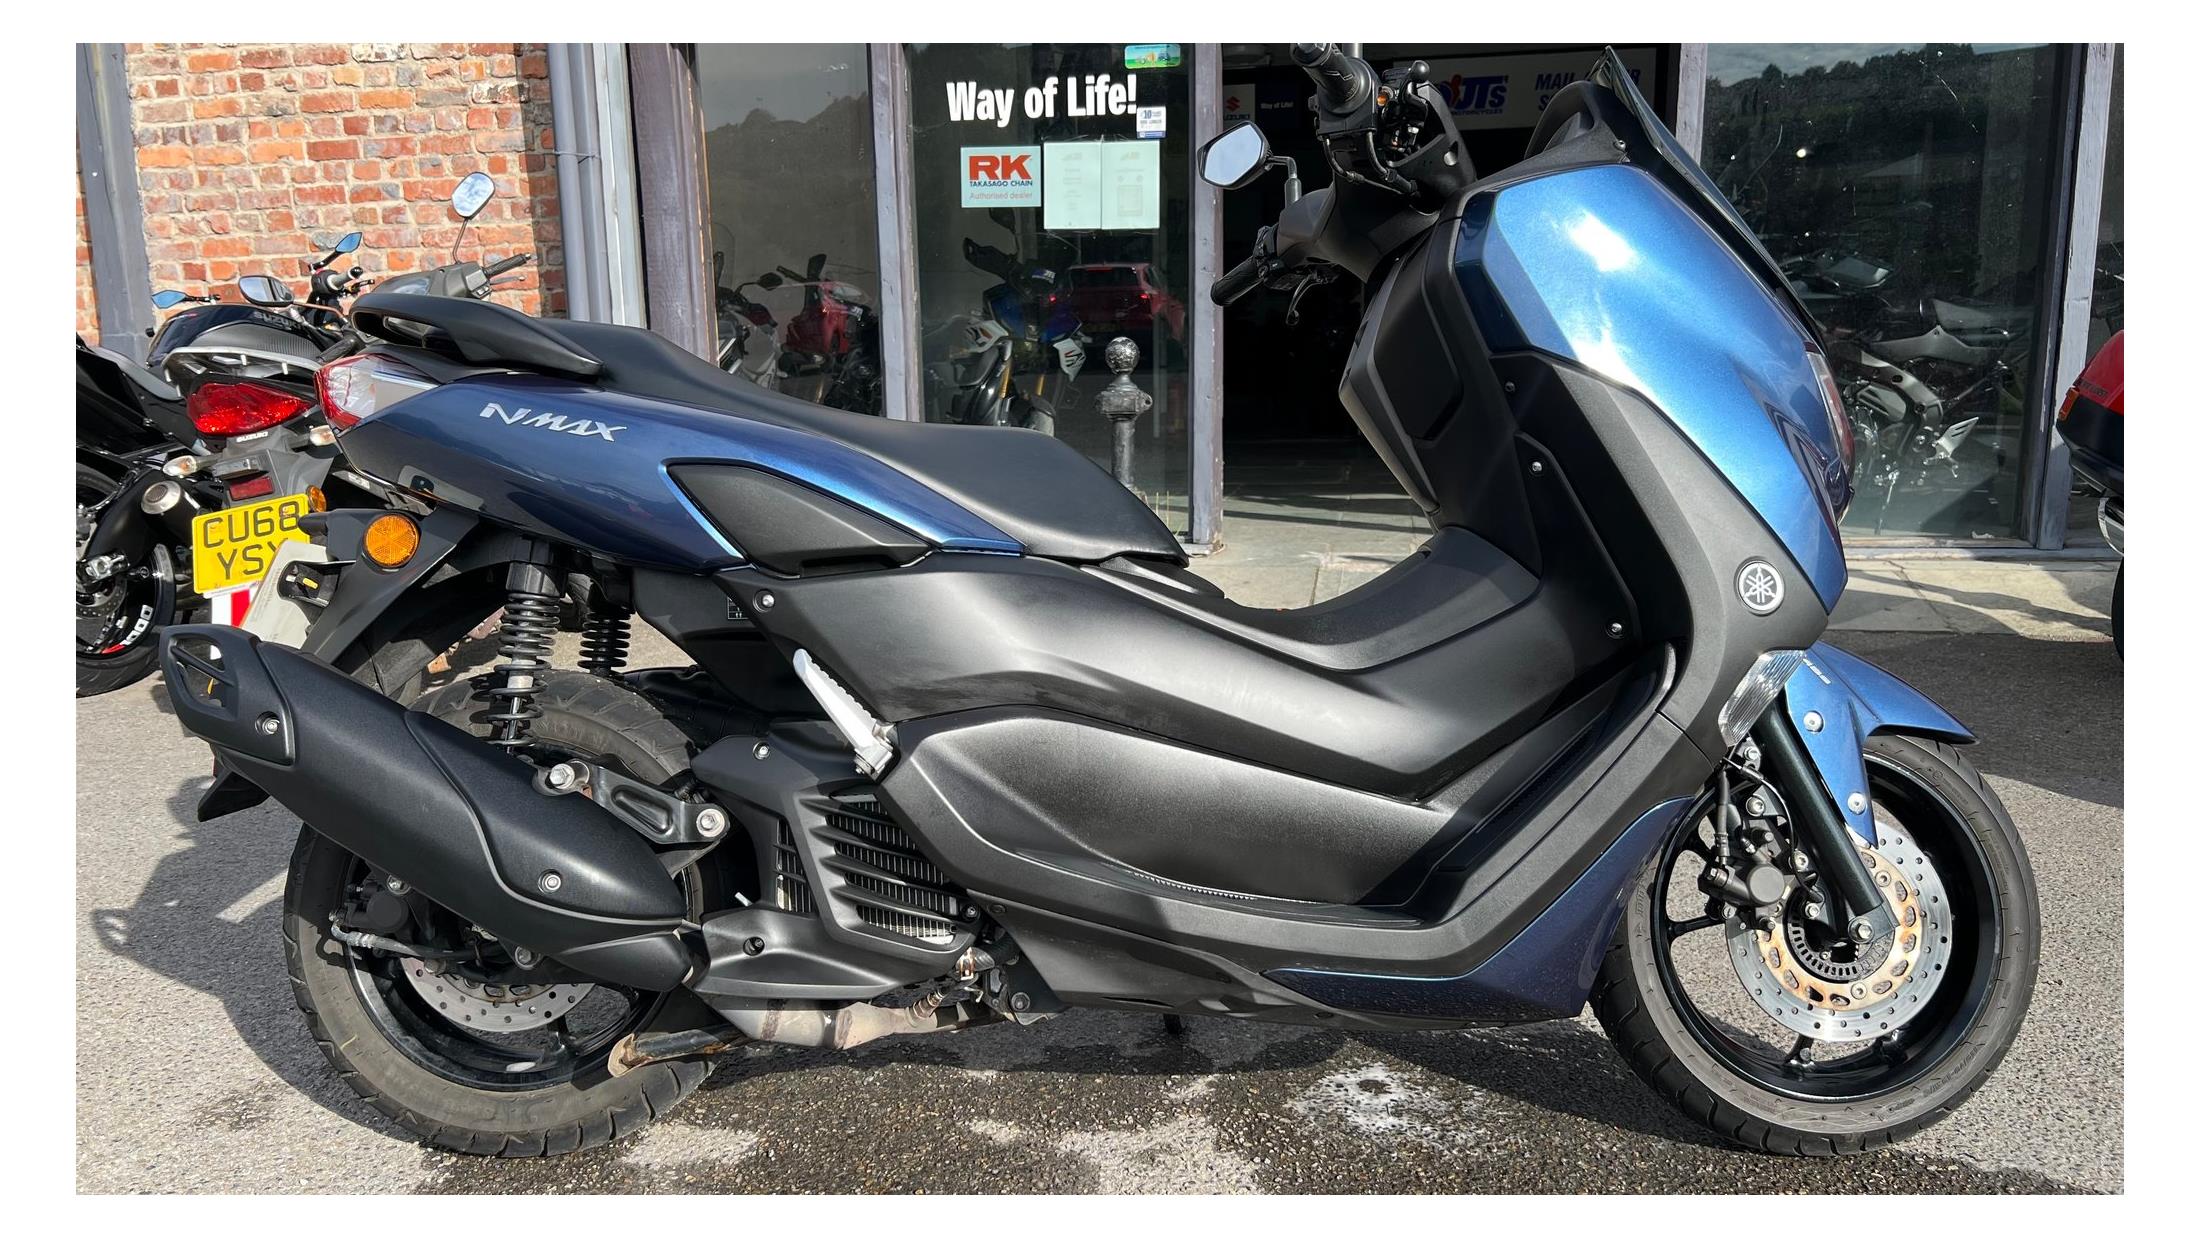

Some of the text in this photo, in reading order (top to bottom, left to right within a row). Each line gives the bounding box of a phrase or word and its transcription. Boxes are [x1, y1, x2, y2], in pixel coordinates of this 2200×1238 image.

[946, 74, 1137, 127] Way of Life!
[969, 154, 1033, 180] RK
[1010, 179, 1033, 187] CHAIN
[236, 431, 268, 443] SUZUKI
[203, 501, 300, 549] CU68
